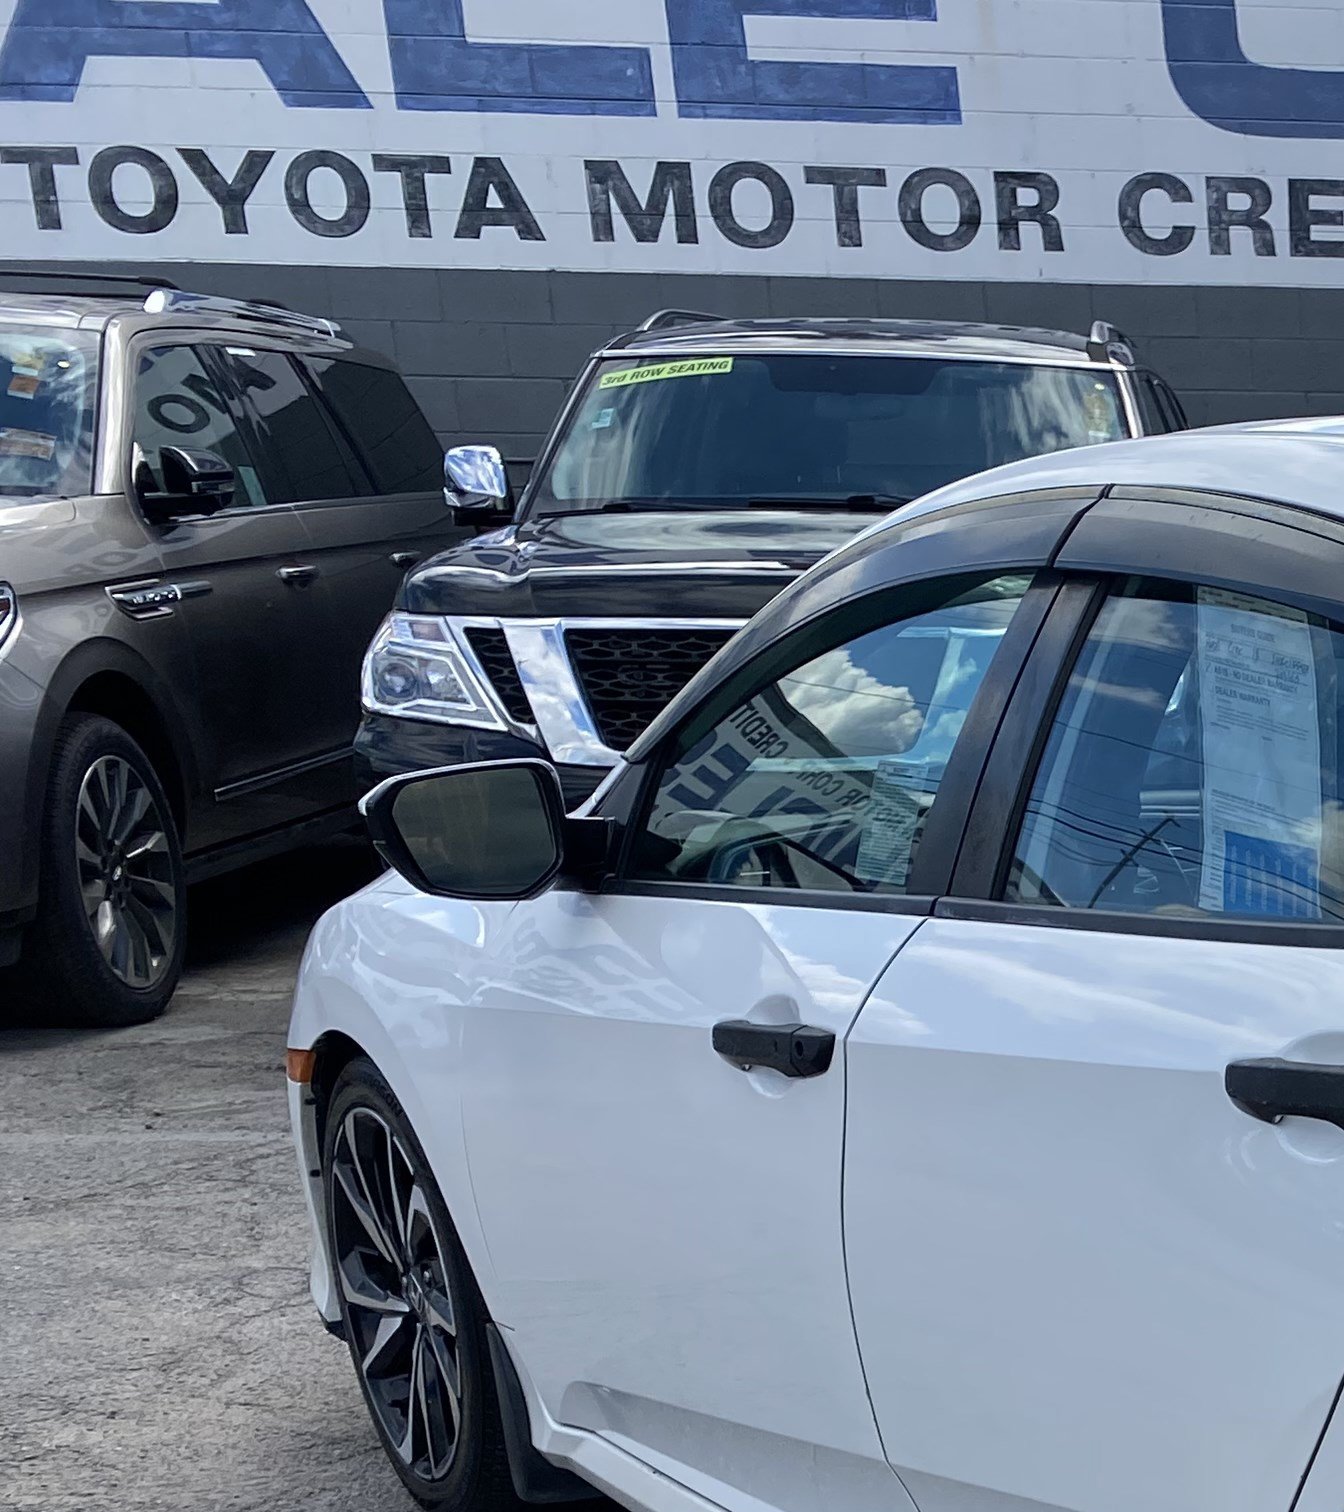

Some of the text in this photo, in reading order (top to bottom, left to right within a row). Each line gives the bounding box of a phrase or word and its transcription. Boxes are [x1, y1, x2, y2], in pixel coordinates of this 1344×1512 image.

[0, 146, 546, 241] TOYOTA
[584, 160, 1065, 252] MOTOR
[602, 360, 730, 386] 3rd ROW SEATING
